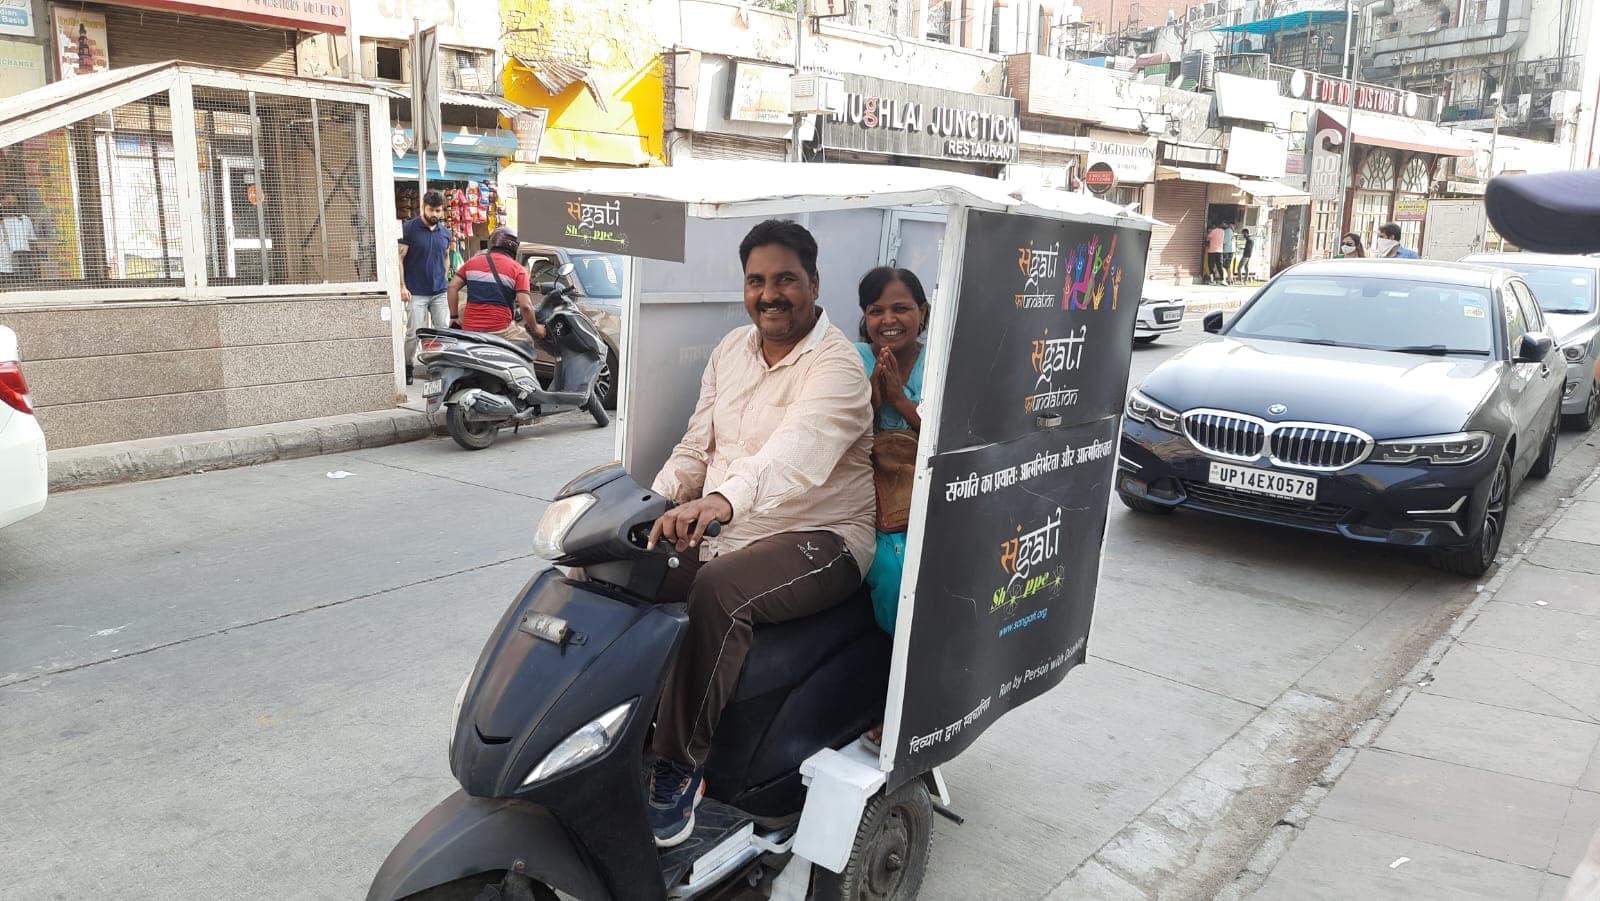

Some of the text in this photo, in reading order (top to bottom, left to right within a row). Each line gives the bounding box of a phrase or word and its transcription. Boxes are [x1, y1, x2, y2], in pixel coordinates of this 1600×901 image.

[930, 107, 1018, 142] JUNCTION
[947, 140, 1017, 159] RESTAURANT
[945, 472, 979, 502] संगति
[981, 474, 993, 494] का
[1019, 451, 1059, 482] आत्मनिर्भरता
[1060, 445, 1074, 468] और
[1220, 467, 1314, 496] UP14EX0578
[1012, 675, 1023, 689] by
[1024, 664, 1049, 683] Person
[909, 728, 943, 755] दिव्यांग
[945, 719, 963, 742] द्वारा
